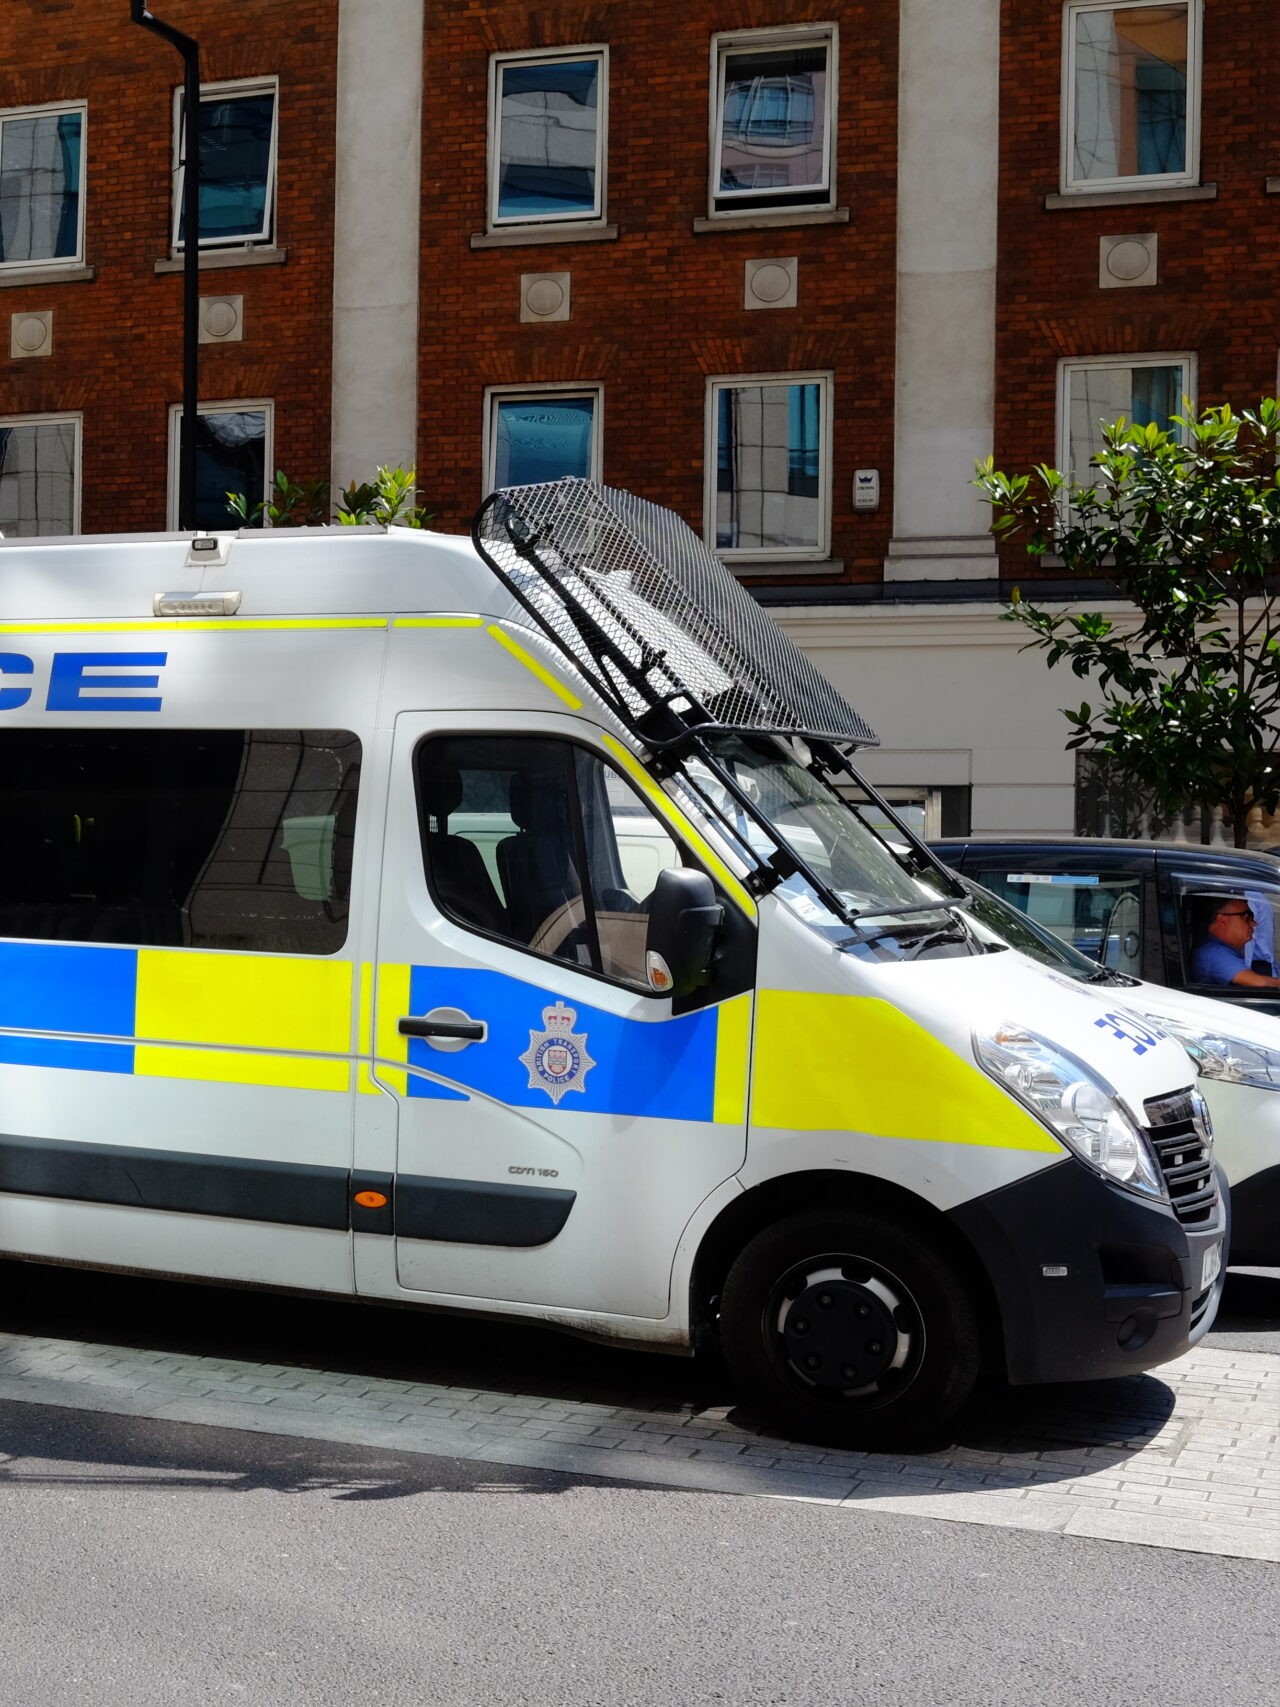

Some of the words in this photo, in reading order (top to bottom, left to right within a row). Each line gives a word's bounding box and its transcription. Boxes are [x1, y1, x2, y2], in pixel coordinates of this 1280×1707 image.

[535, 1041, 551, 1072] BRITISH
[552, 1038, 580, 1075] TRANSPORT
[542, 1072, 570, 1084] POLICE
